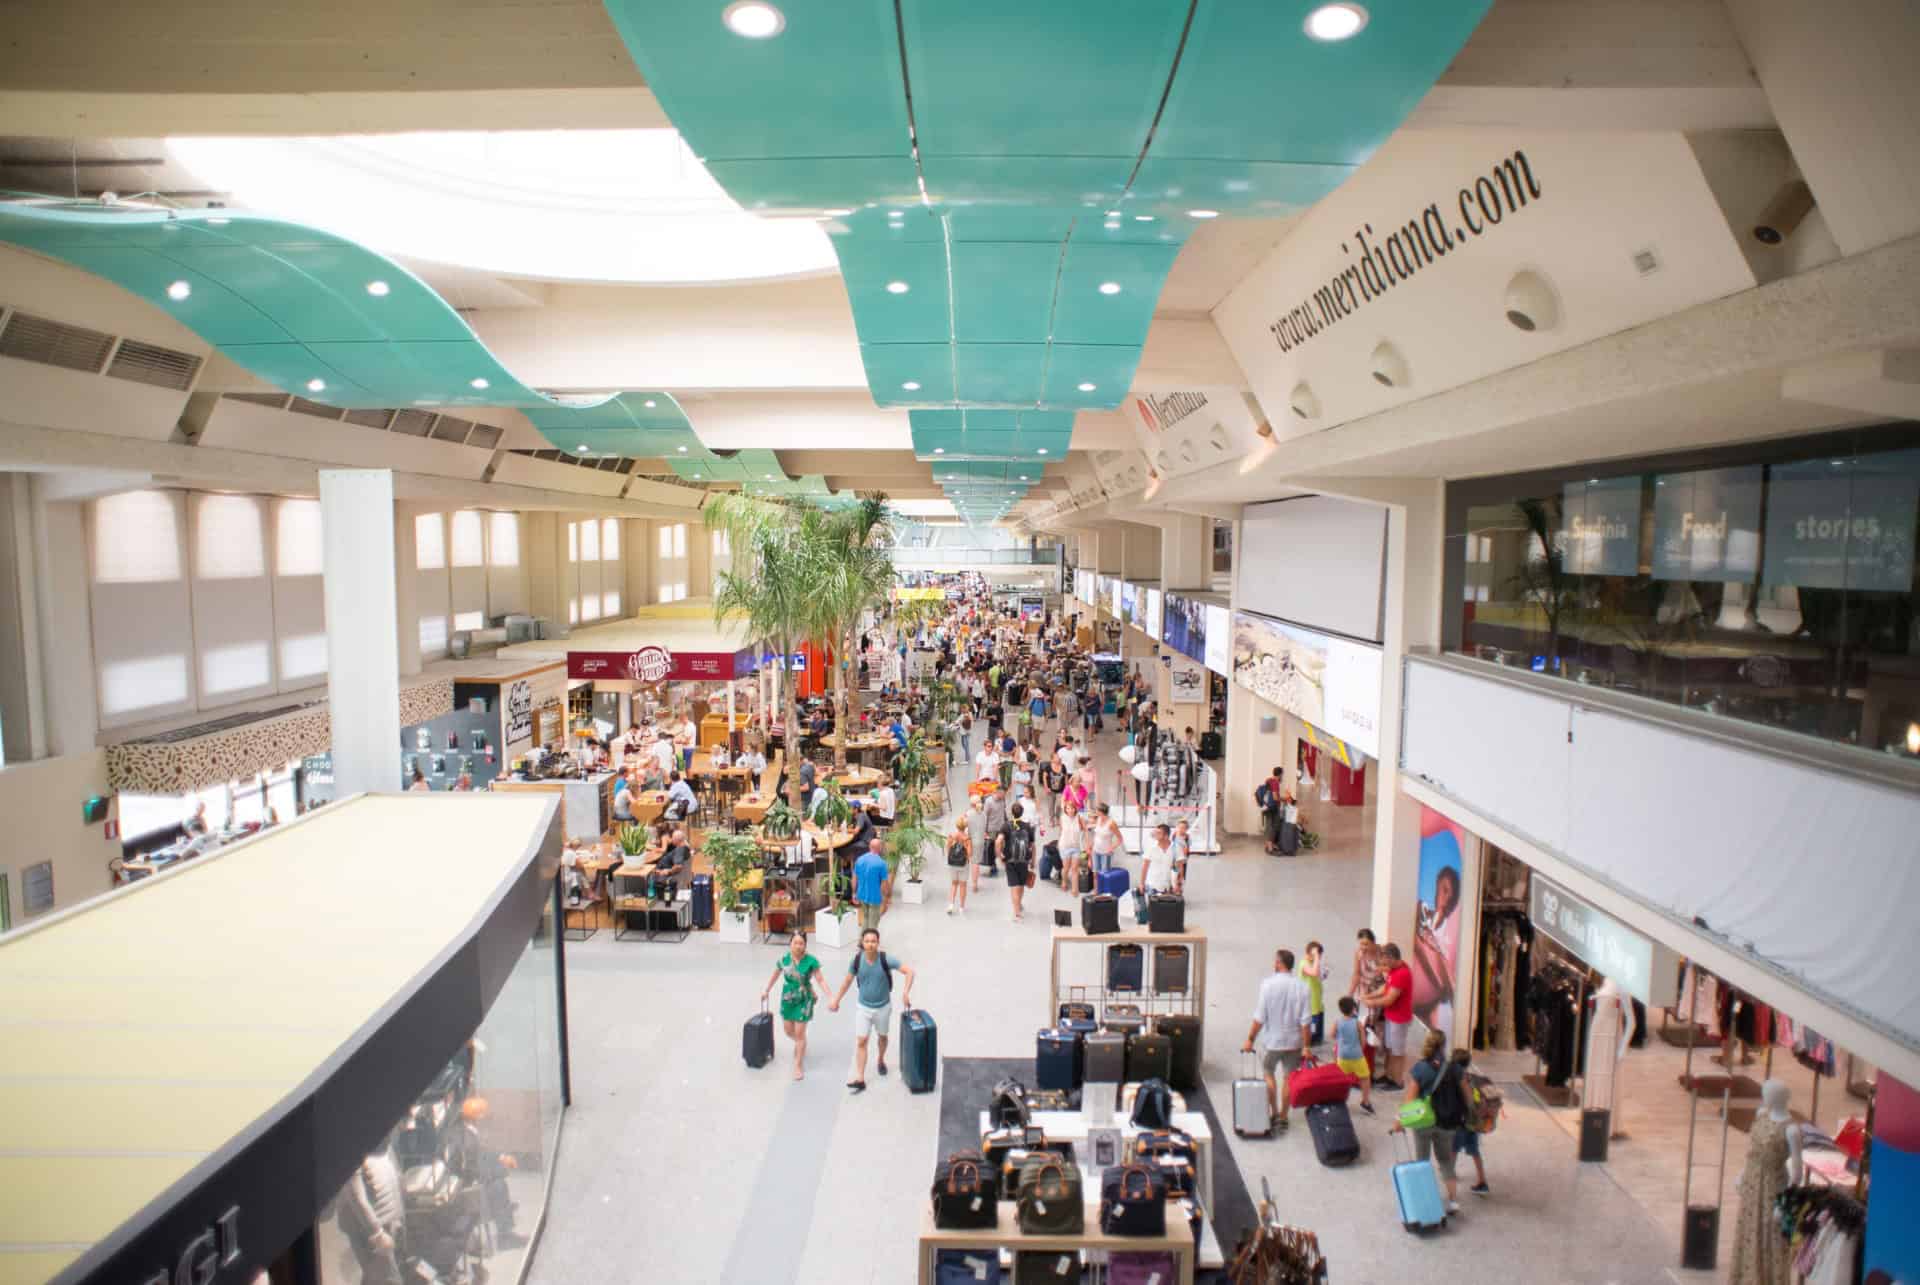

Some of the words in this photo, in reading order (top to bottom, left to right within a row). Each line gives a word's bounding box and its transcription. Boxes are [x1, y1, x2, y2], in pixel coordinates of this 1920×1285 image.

[1268, 148, 1543, 354] www.meridiana.com
[1570, 512, 1628, 539] Sdinia
[1681, 511, 1728, 539] Food
[1794, 507, 1881, 541] stories
